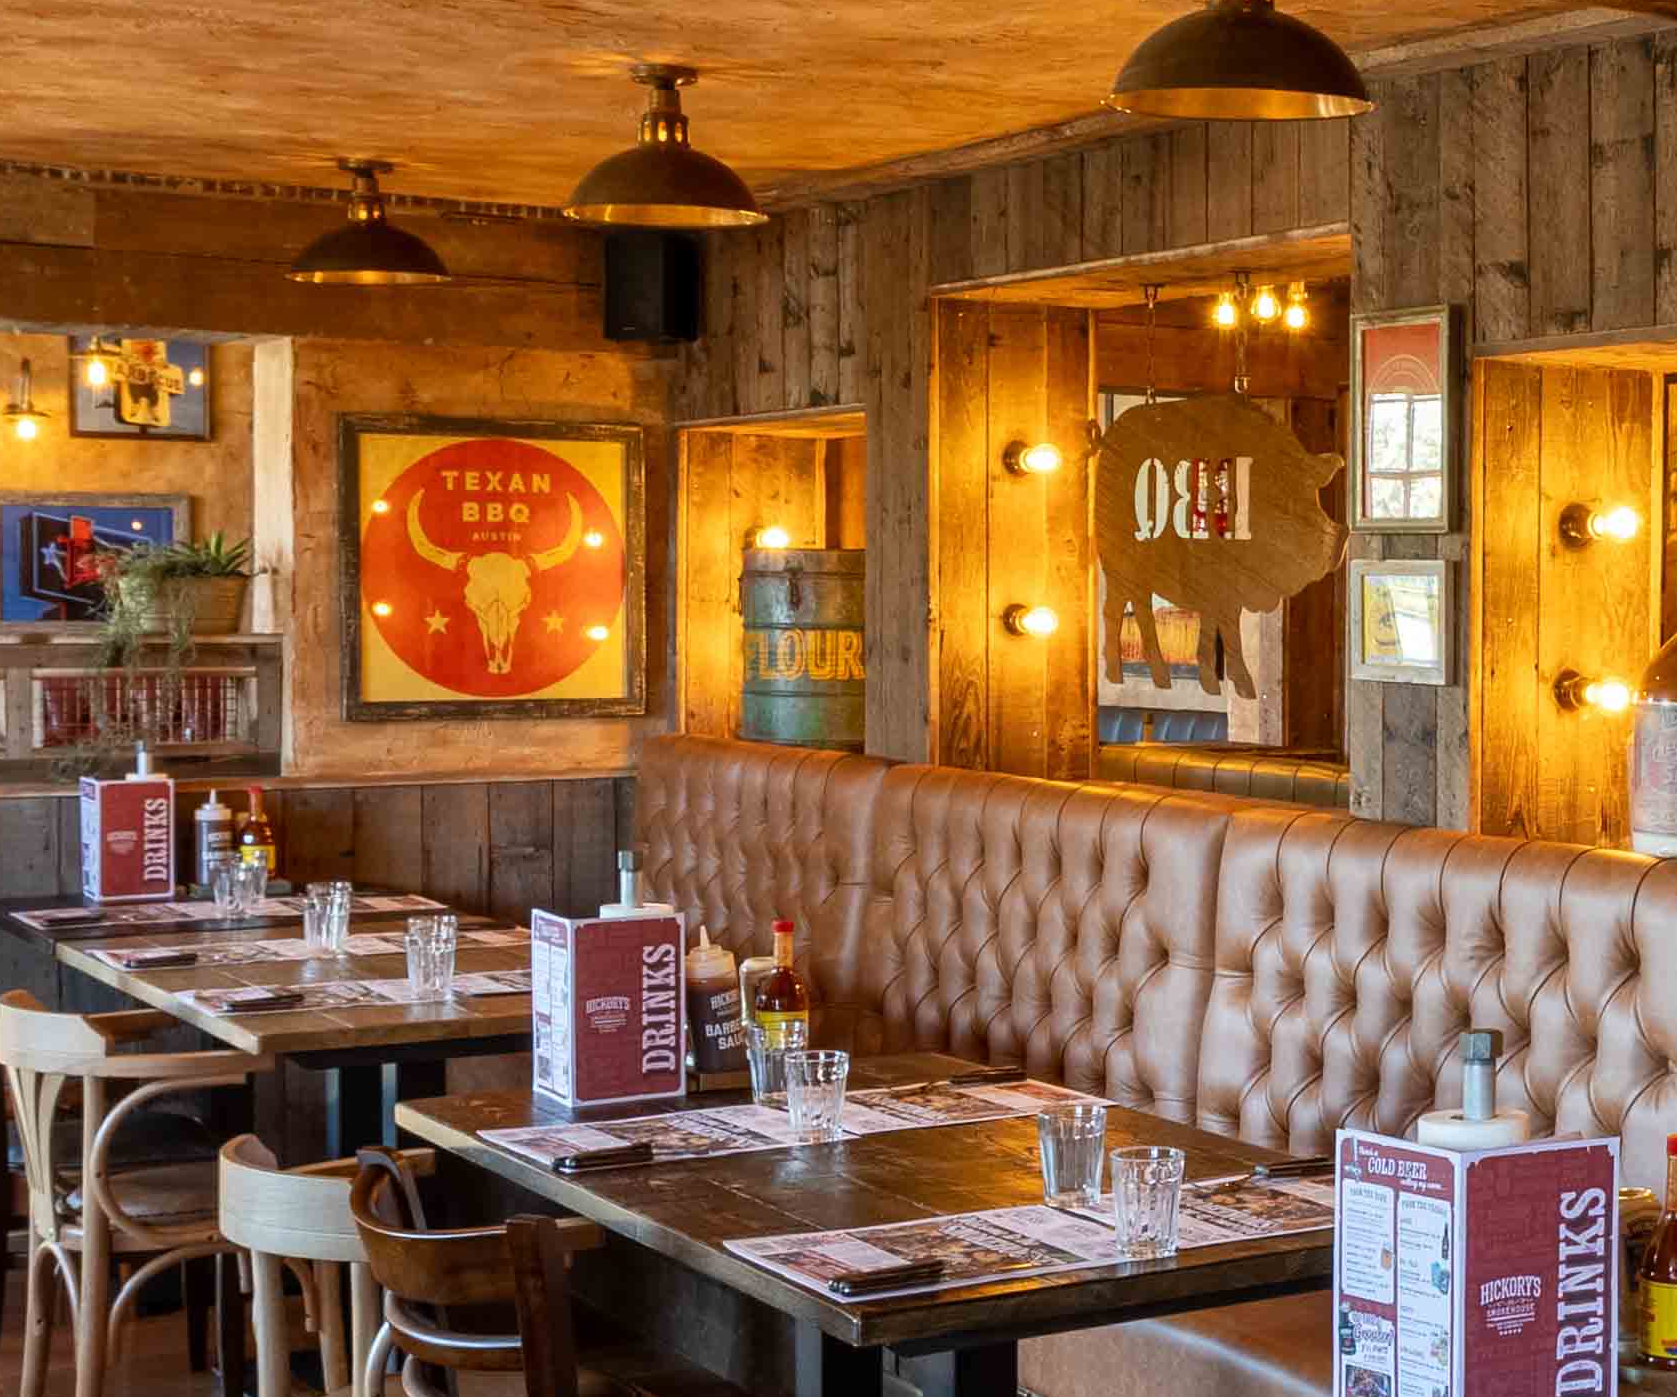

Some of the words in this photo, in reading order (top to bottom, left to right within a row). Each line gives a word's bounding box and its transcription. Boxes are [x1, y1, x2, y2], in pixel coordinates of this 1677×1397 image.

[440, 470, 551, 494] TEXAN
[461, 501, 531, 523] BBQ
[472, 531, 522, 542] AUSTIN
[142, 798, 169, 882] DRINKS
[642, 942, 676, 1074] DRINKS
[1368, 1157, 1395, 1176] COLD
[1397, 1160, 1427, 1180] BEER
